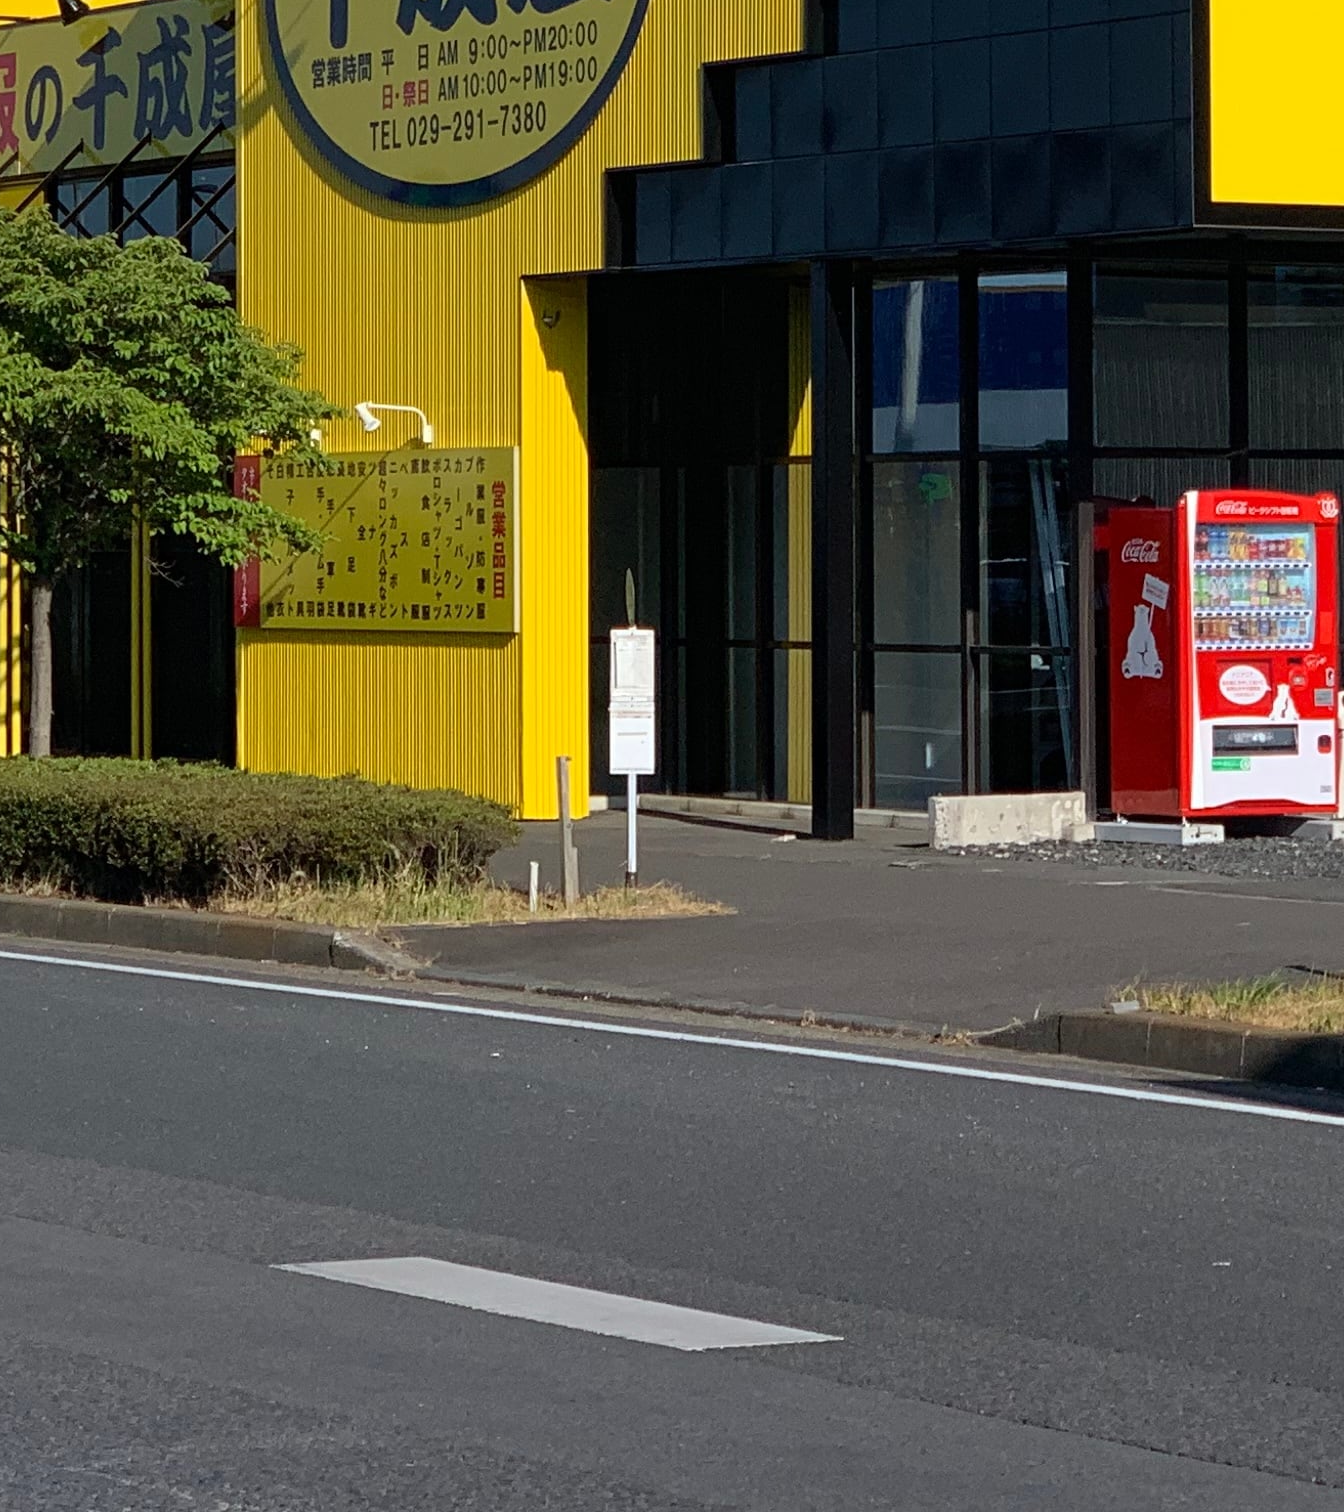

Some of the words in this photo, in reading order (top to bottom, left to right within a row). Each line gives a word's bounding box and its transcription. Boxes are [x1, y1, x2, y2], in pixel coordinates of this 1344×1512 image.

[312, 52, 372, 88] 営業時間
[492, 480, 506, 600] 営業品目
